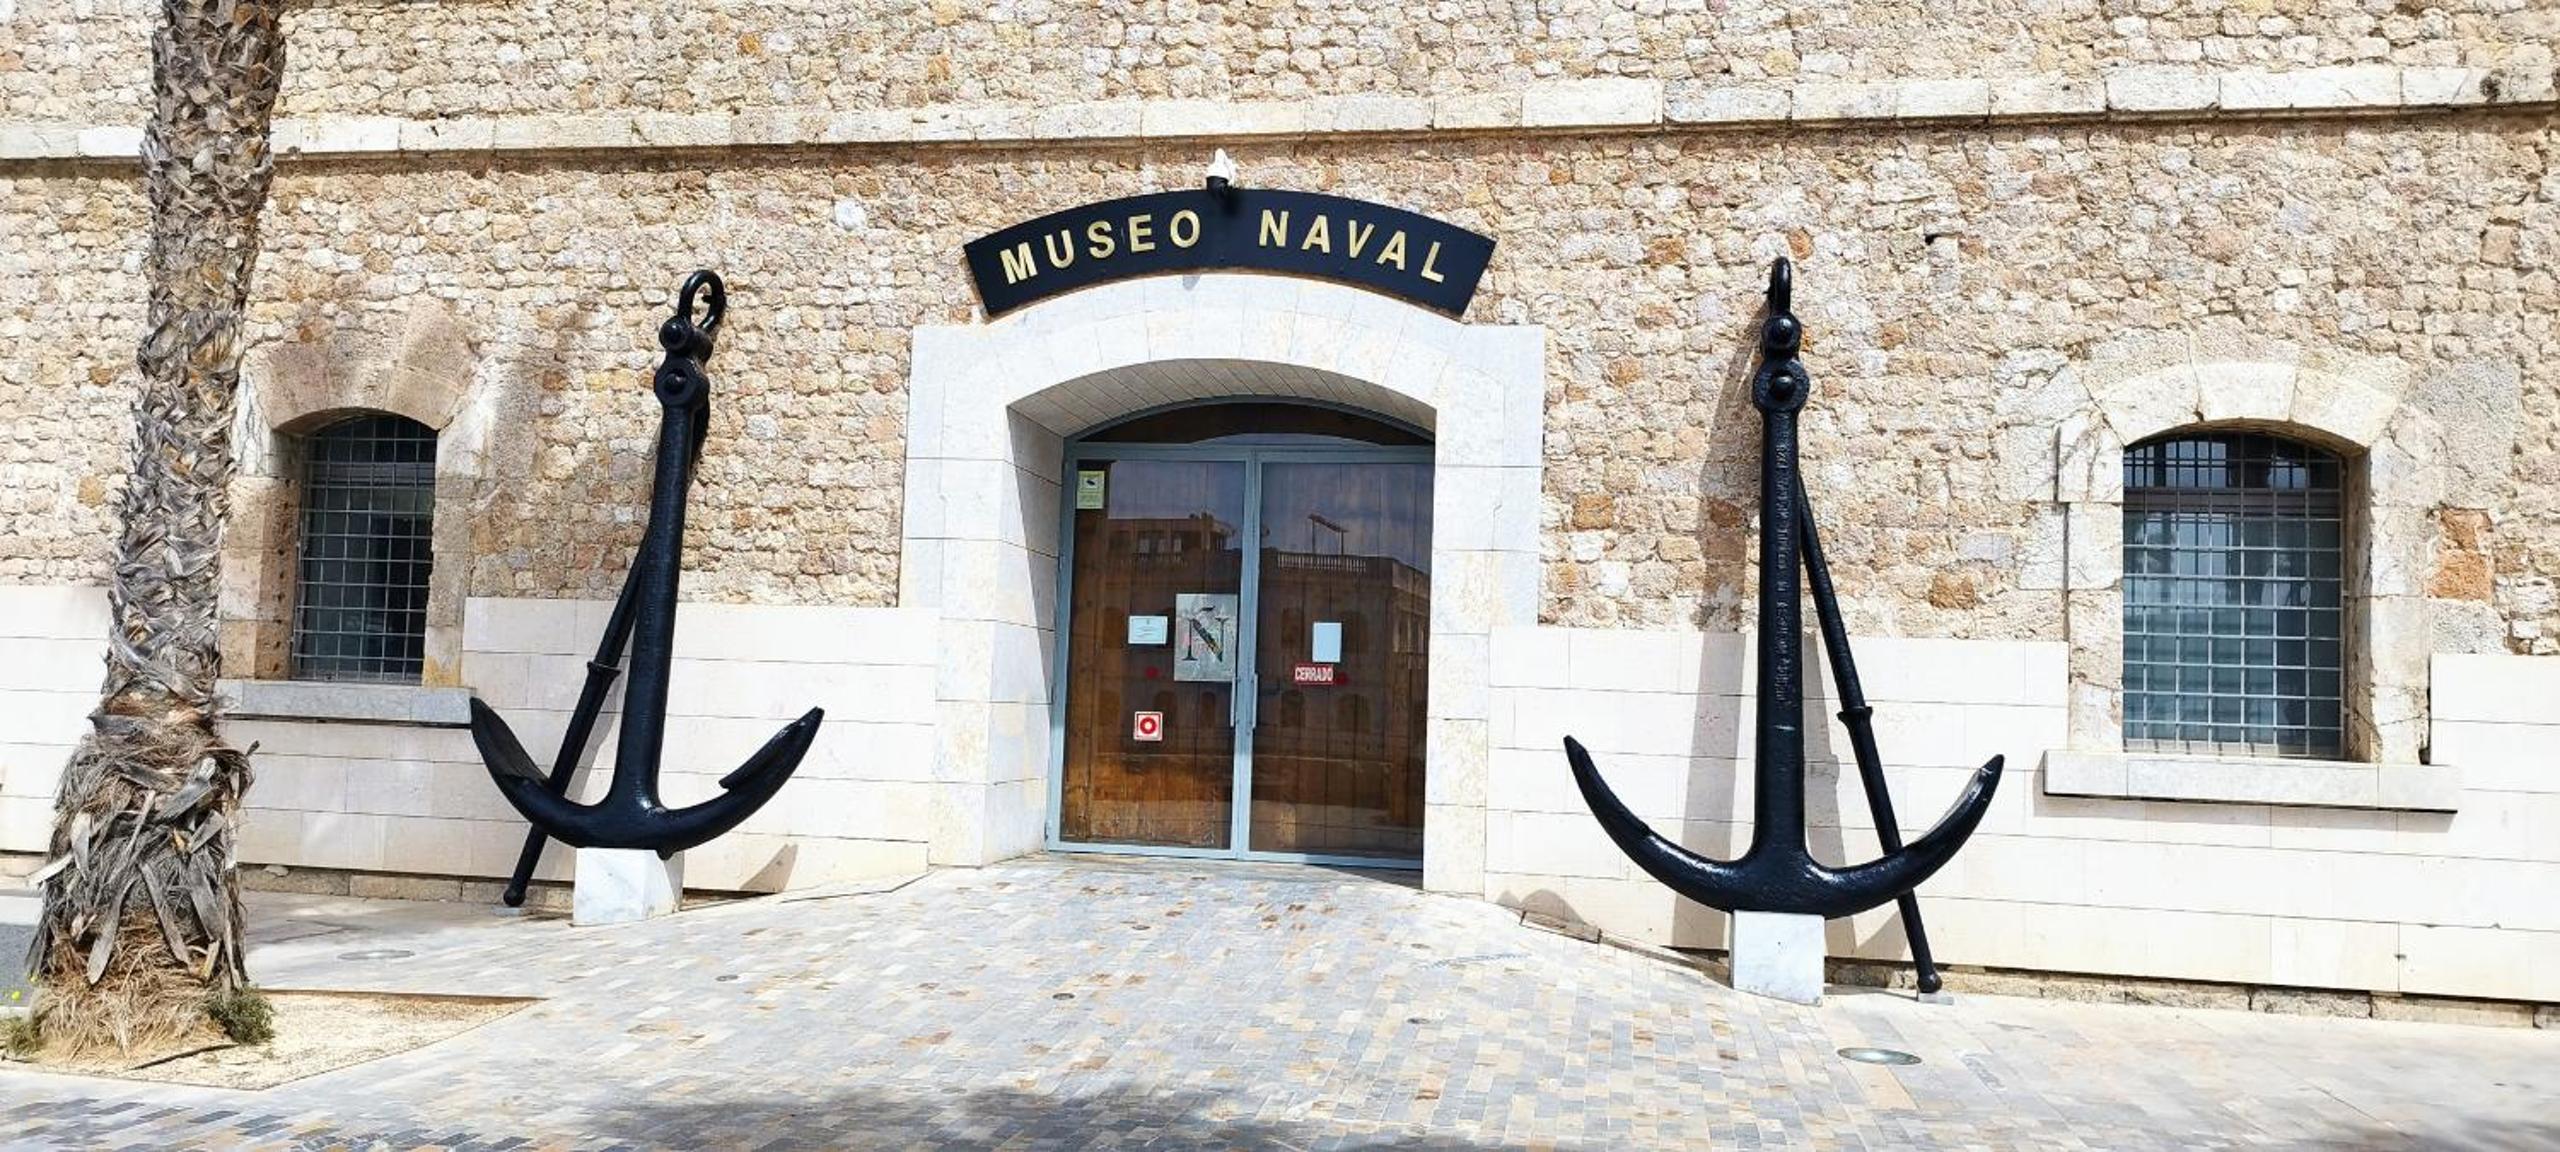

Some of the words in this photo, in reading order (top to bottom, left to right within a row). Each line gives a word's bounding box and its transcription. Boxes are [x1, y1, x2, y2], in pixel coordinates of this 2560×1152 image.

[999, 209, 1202, 285] MUSEO
[1258, 209, 1446, 283] NAVAL
[1181, 606, 1230, 663] Ñ
[1295, 666, 1334, 682] CERRADO
